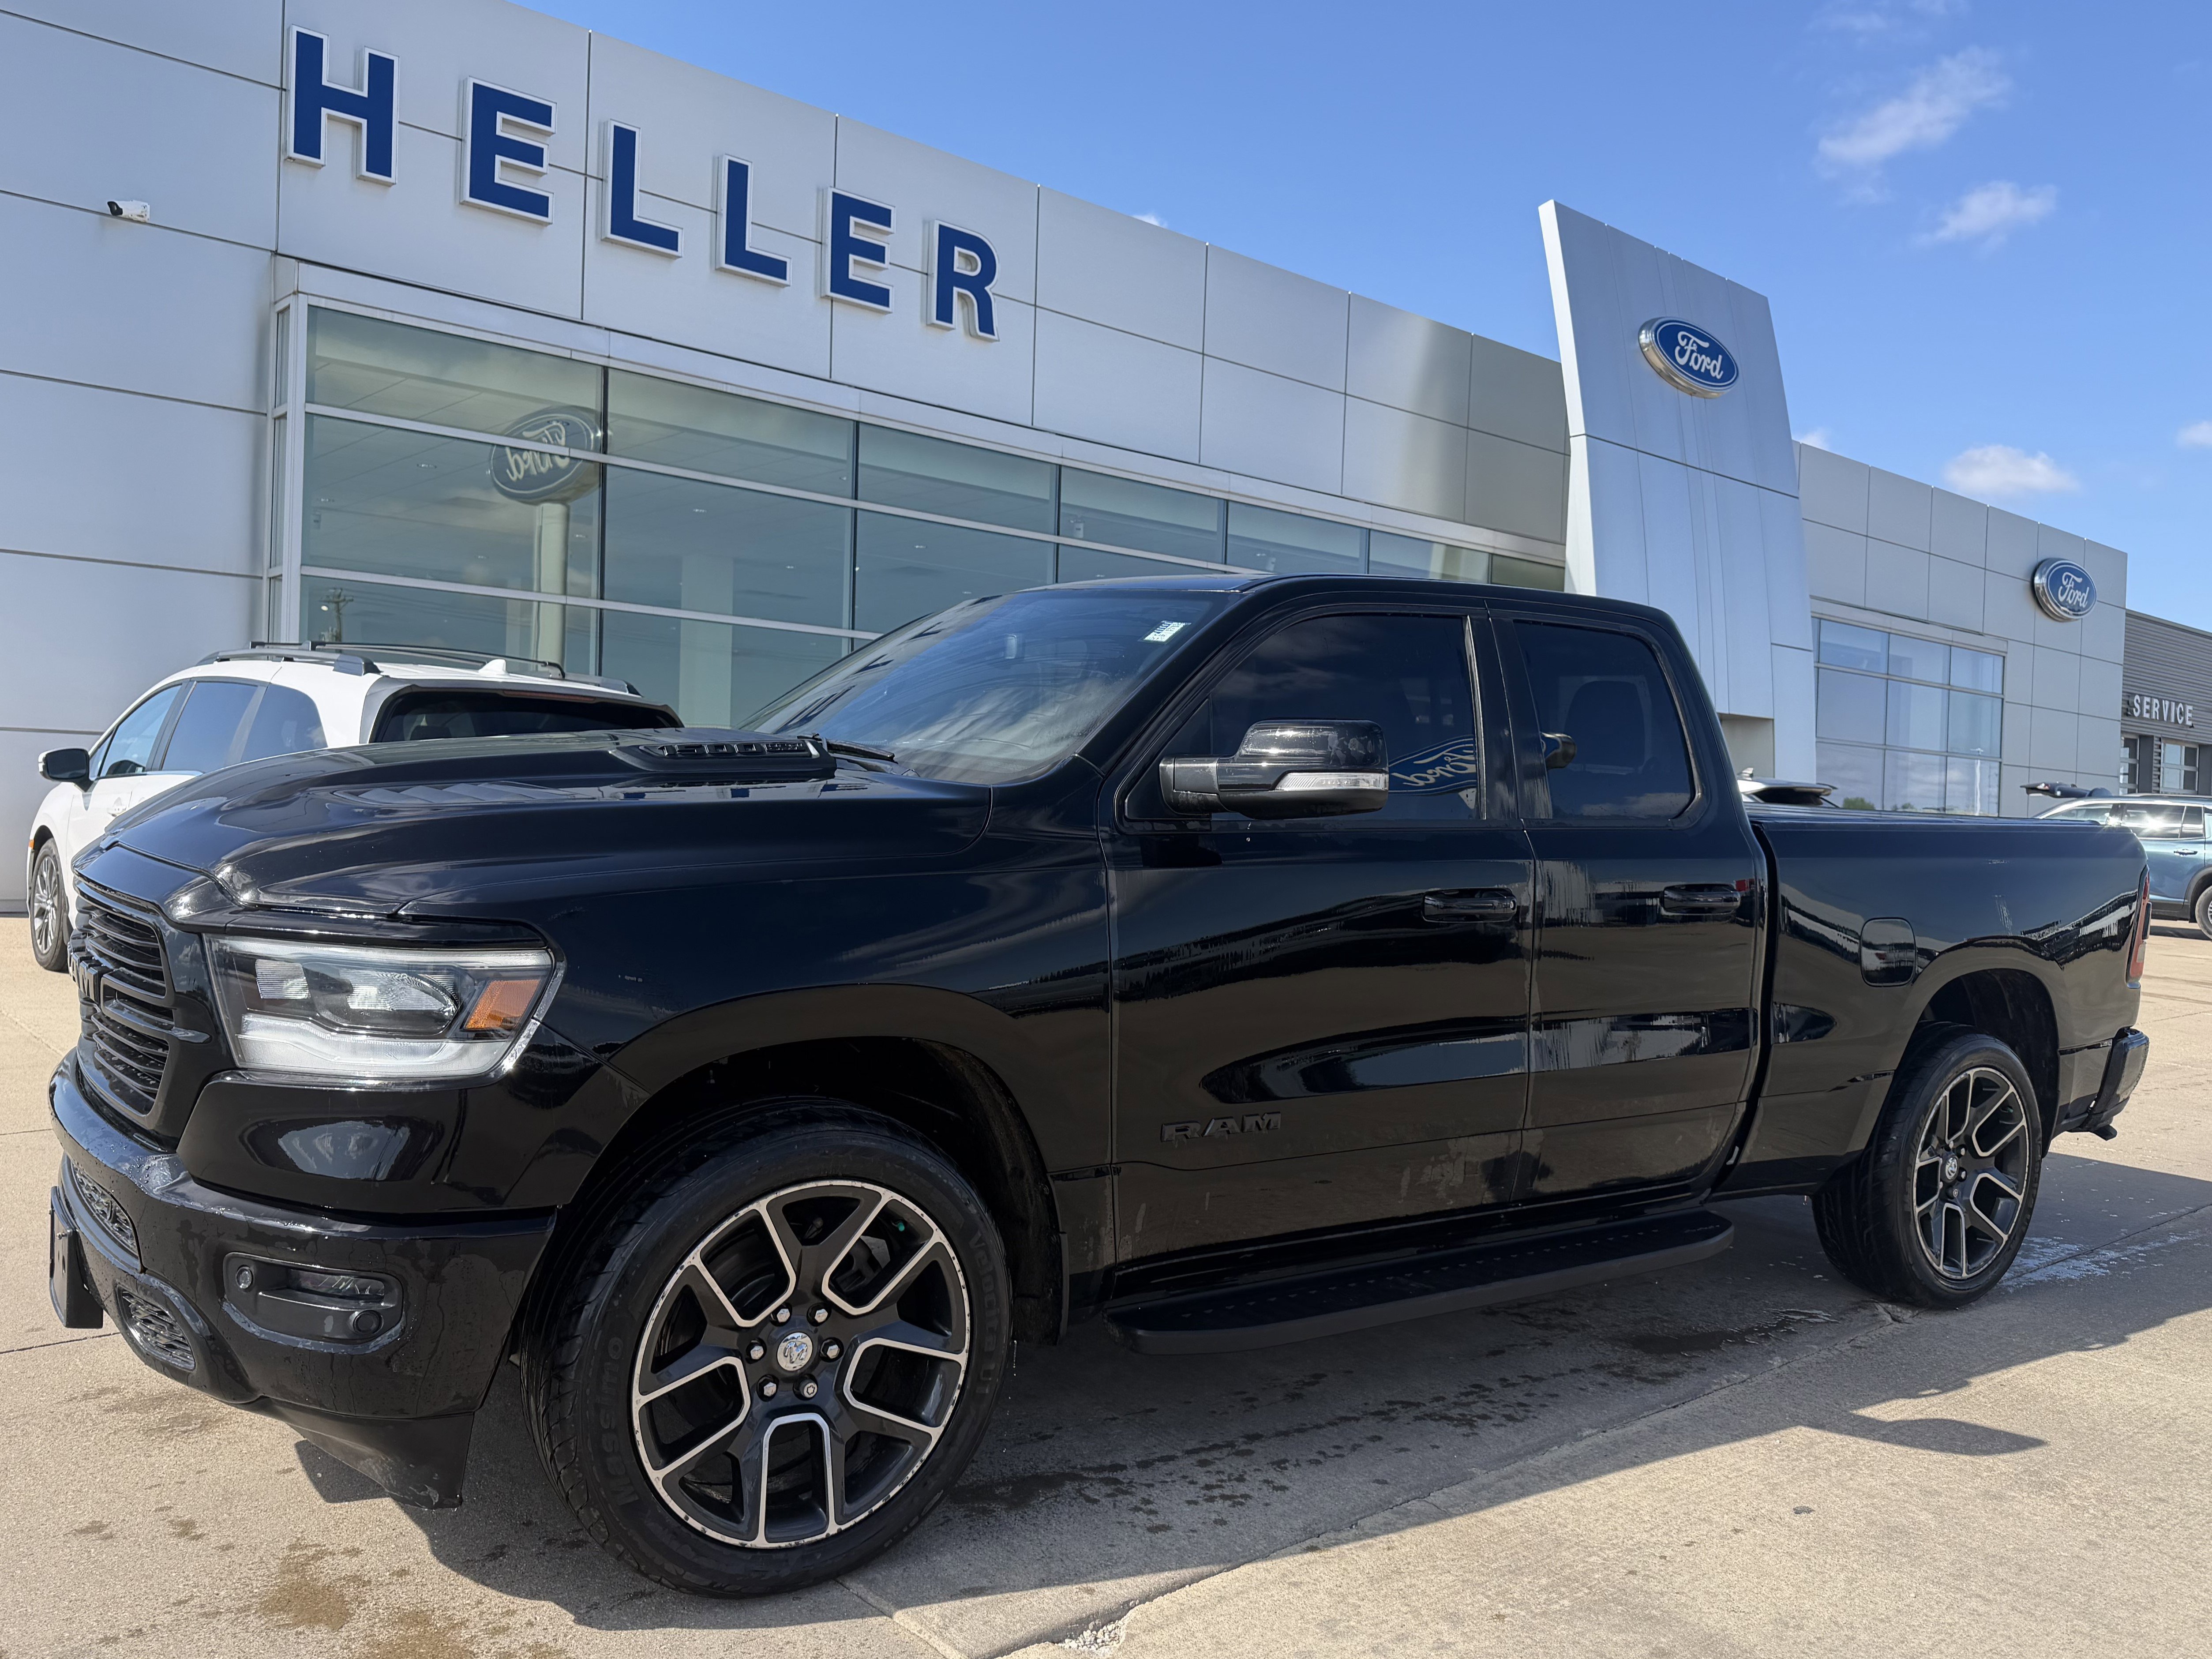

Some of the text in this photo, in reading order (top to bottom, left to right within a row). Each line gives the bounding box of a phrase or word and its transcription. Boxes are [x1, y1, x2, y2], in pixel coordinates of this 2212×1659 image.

[285, 23, 1001, 342] HELLER
[1675, 331, 1724, 379] Ford
[2058, 572, 2089, 608] Ford
[2133, 694, 2193, 727] SERVICE
[1160, 1111, 1281, 1142] RAM
[968, 1229, 1000, 1352] Velocita
[595, 1337, 639, 1506] Massimo
